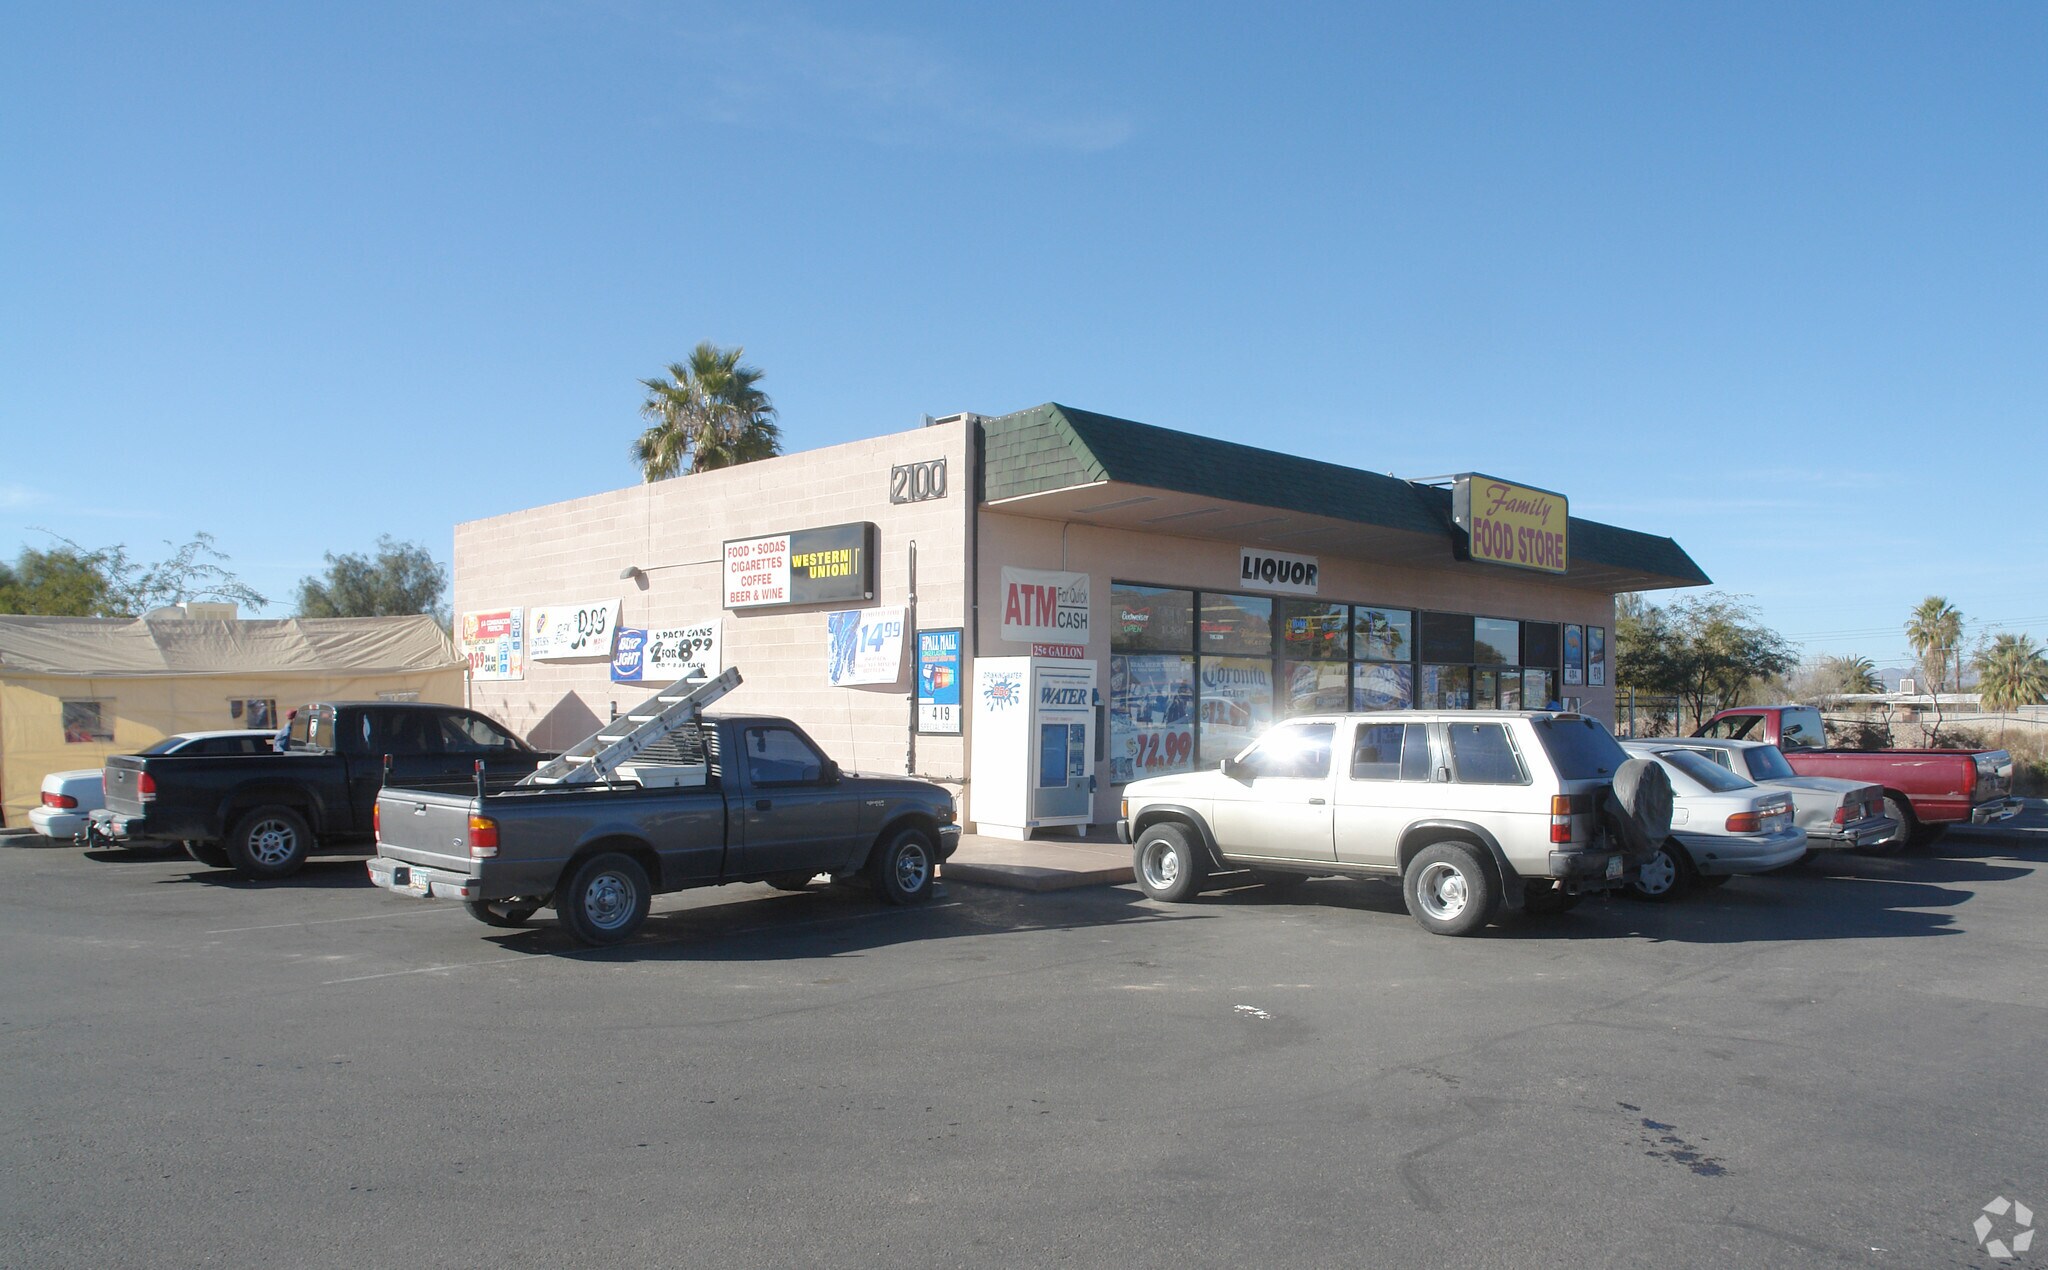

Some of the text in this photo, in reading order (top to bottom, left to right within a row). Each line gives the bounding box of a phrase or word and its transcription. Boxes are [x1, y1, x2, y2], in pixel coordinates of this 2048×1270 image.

[891, 460, 945, 503] 2100
[1486, 484, 1552, 526] Family
[728, 540, 786, 558] FOOD SODAS
[1473, 516, 1564, 568] FOOD STORE
[731, 556, 782, 572] CIGARETTES
[792, 550, 848, 568] WESTERN
[809, 562, 848, 579] UNION
[1242, 556, 1318, 586] LIQUOR
[741, 573, 772, 587] COFFEE
[730, 587, 783, 602] BEER & WINE
[1004, 582, 1088, 628] ATM For Quick
[1058, 612, 1088, 629] CASH
[663, 630, 684, 639] PACK
[940, 634, 956, 650] MALL
[650, 642, 663, 662] 2
[662, 650, 676, 658] FOR
[1049, 646, 1083, 657] GALLON
[1202, 662, 1266, 690] Coronita
[1041, 688, 1087, 705] WATER
[932, 707, 950, 720] 419
